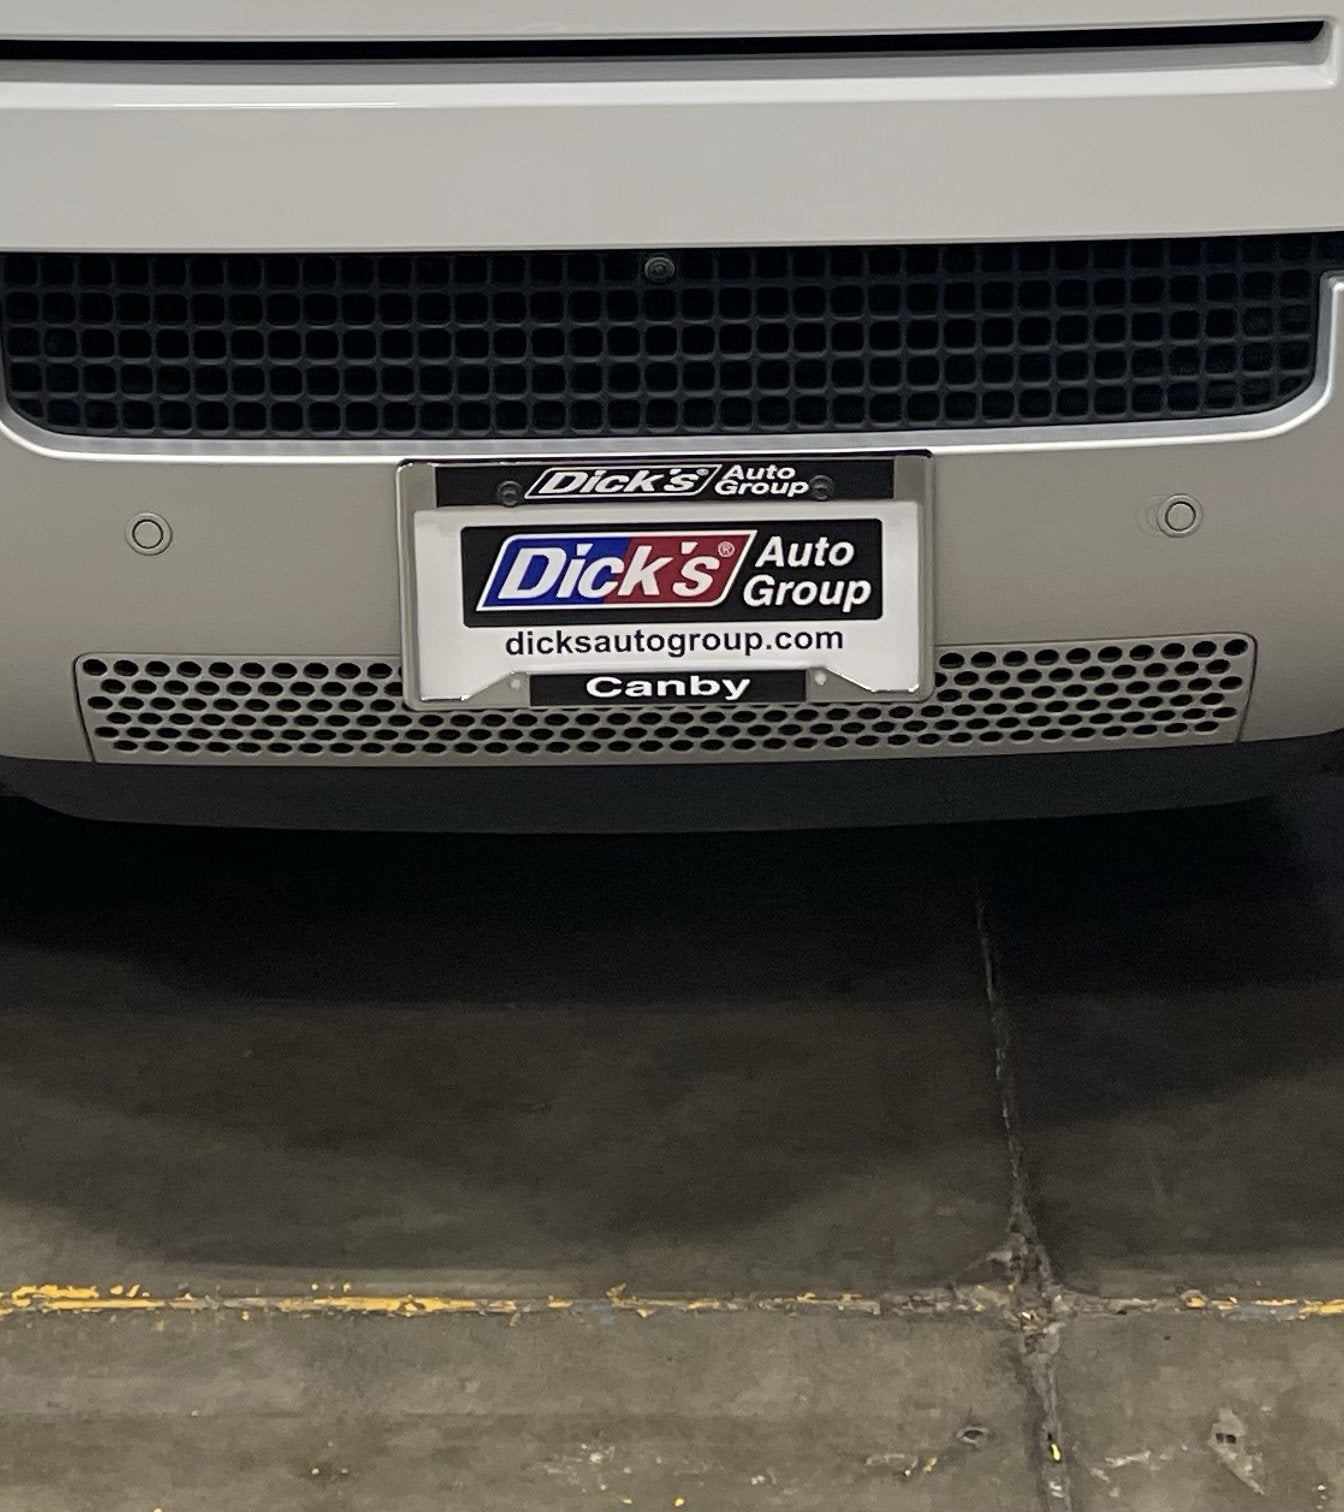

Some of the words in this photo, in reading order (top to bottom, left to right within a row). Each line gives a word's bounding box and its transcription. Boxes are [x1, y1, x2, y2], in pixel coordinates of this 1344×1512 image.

[722, 464, 796, 480] Auto
[714, 478, 809, 497] Group
[754, 535, 855, 569] Auto
[743, 574, 872, 612] Group
[504, 629, 844, 658] dicksautogroup.com
[585, 674, 751, 700] Canby
